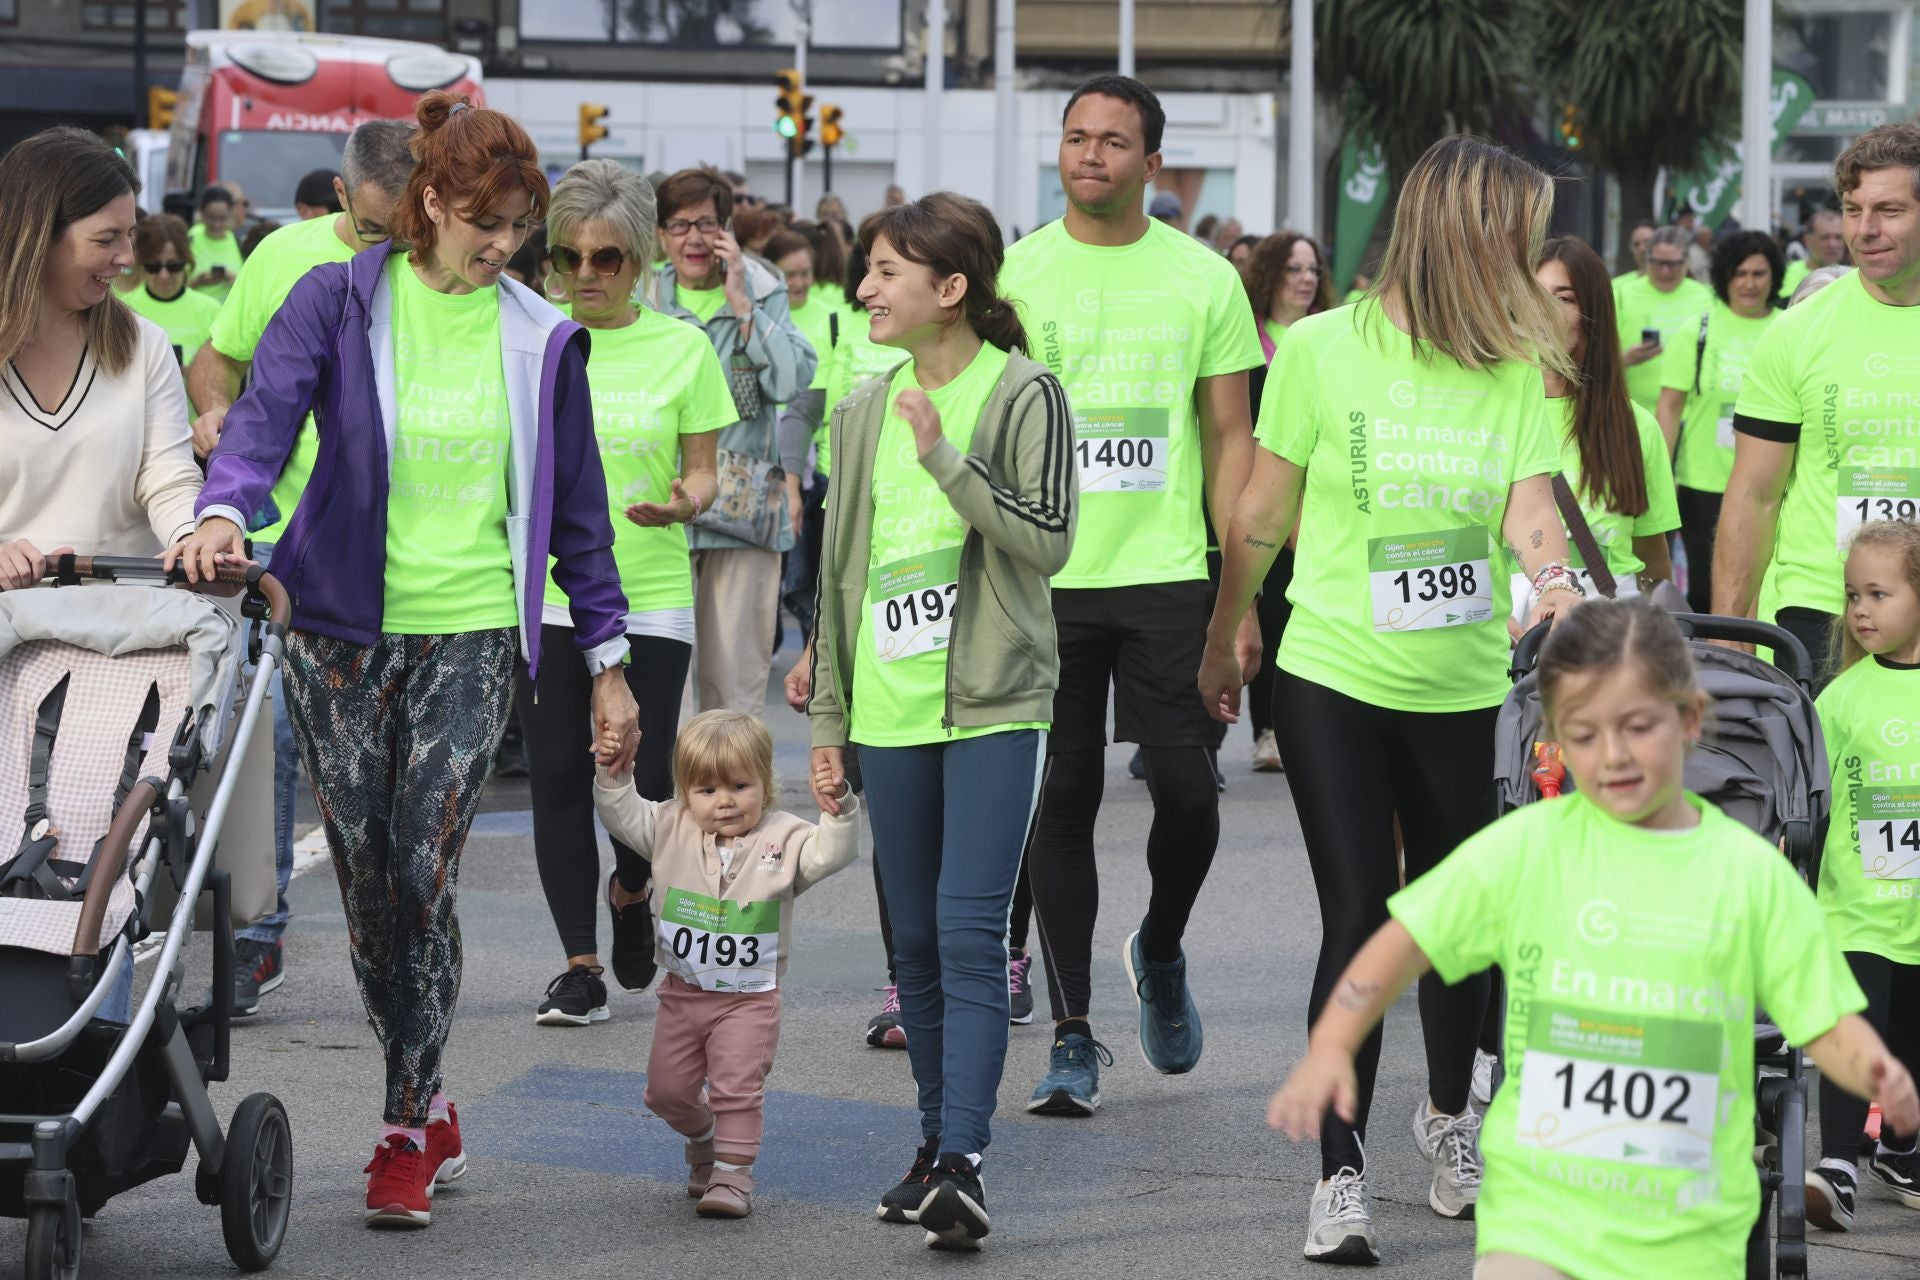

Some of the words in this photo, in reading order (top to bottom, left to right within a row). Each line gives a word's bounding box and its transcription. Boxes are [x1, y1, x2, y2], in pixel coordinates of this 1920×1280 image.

[1042, 320, 1062, 375] URIAS
[1064, 324, 1094, 344] En
[1100, 320, 1188, 344] marcha
[1065, 350, 1156, 374] contra
[1161, 349, 1185, 373] el
[1844, 386, 1878, 408] En
[400, 403, 476, 430] ntra
[595, 407, 636, 430] tra
[1823, 382, 1840, 471] ASTURIAS
[1843, 412, 1920, 437] cont
[1374, 418, 1408, 440] En
[1415, 427, 1508, 452] marcha
[1077, 439, 1153, 468] 1400
[1349, 411, 1371, 515] ASTURIAS
[1375, 449, 1480, 477] contra
[1482, 458, 1507, 484] el
[1847, 438, 1917, 468] cán
[879, 481, 913, 504] En
[1377, 474, 1504, 516] cáncer
[1856, 498, 1920, 523] 139
[1394, 563, 1477, 603] 1398
[1869, 761, 1902, 782] En
[1879, 820, 1920, 852] 14
[672, 926, 759, 968] 0193
[1551, 957, 1597, 998] En
[1554, 1061, 1691, 1124] 1402
